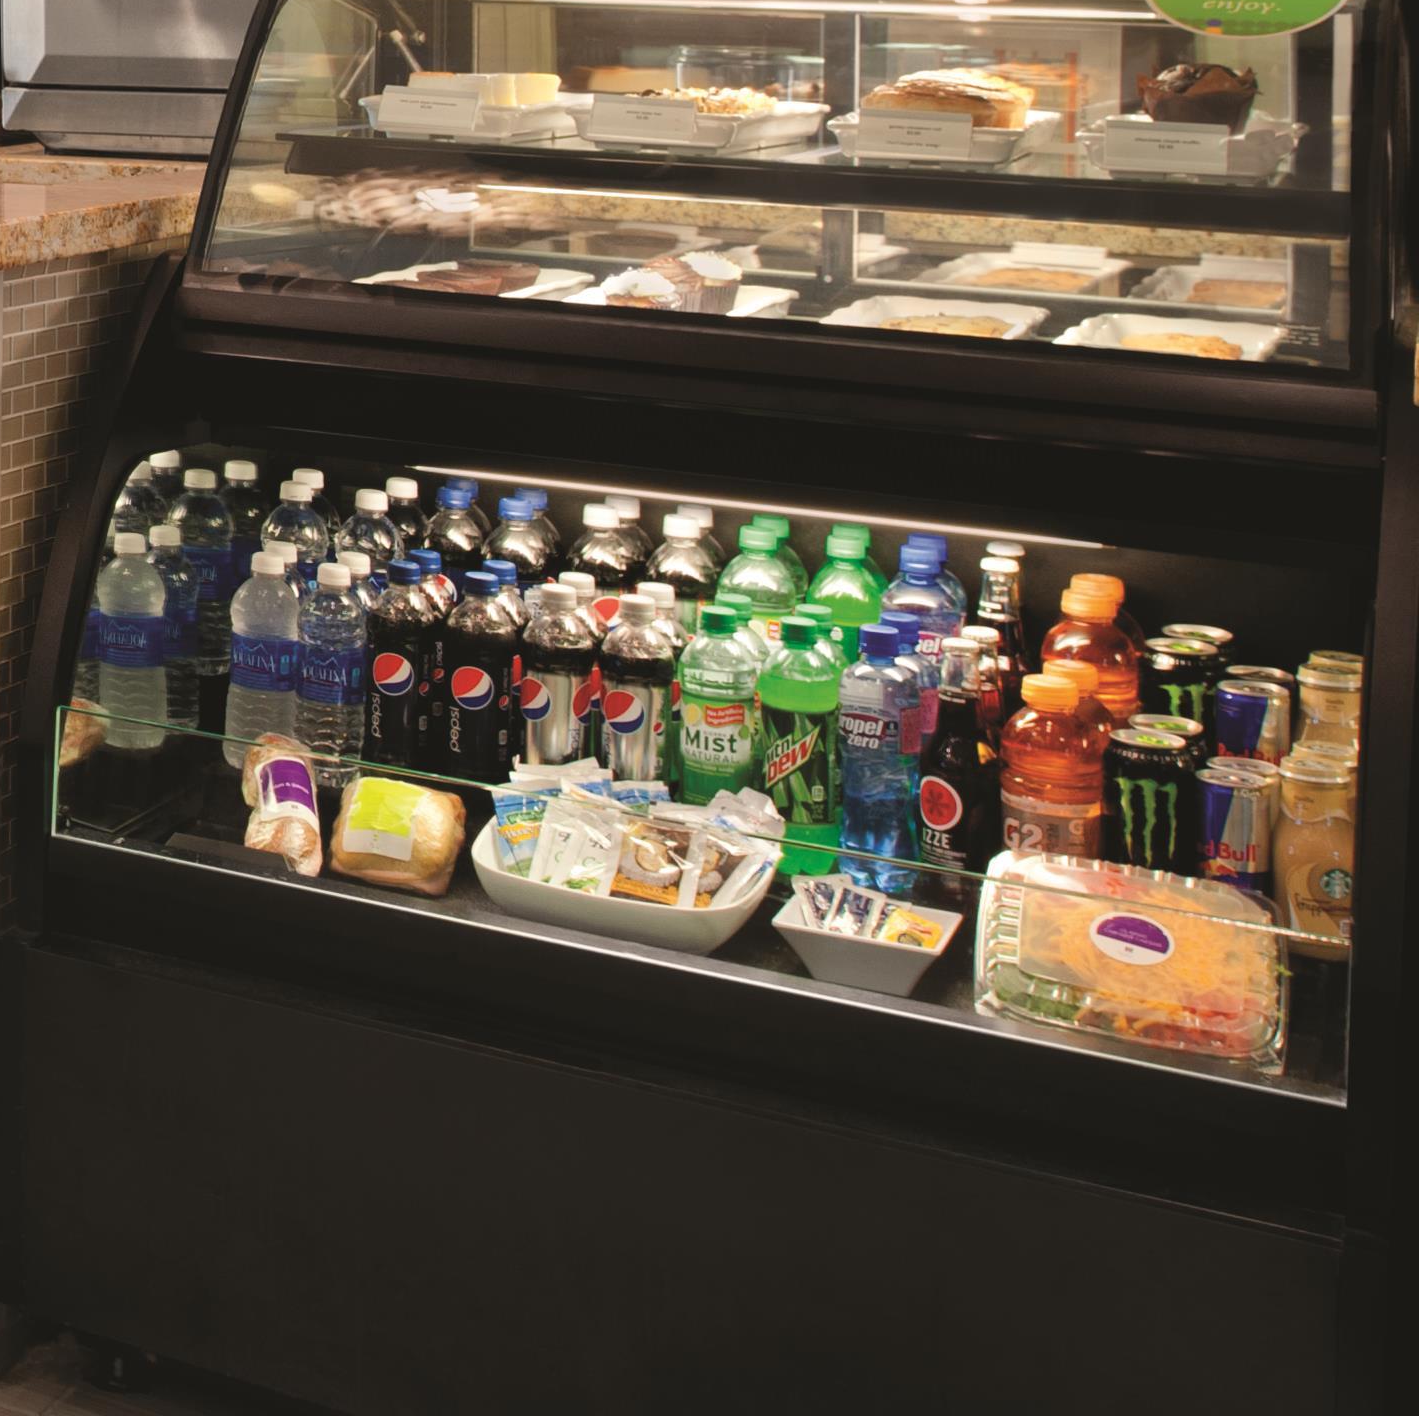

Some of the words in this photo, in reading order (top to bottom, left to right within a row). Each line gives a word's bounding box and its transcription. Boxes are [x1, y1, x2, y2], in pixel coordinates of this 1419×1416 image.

[370, 692, 382, 739] pepsi
[449, 705, 462, 753] pepsi
[685, 726, 737, 753] Mist
[847, 732, 880, 750] zero
[923, 827, 952, 849] IZZE
[1004, 817, 1043, 852] G2
[1217, 843, 1257, 862] Bull
